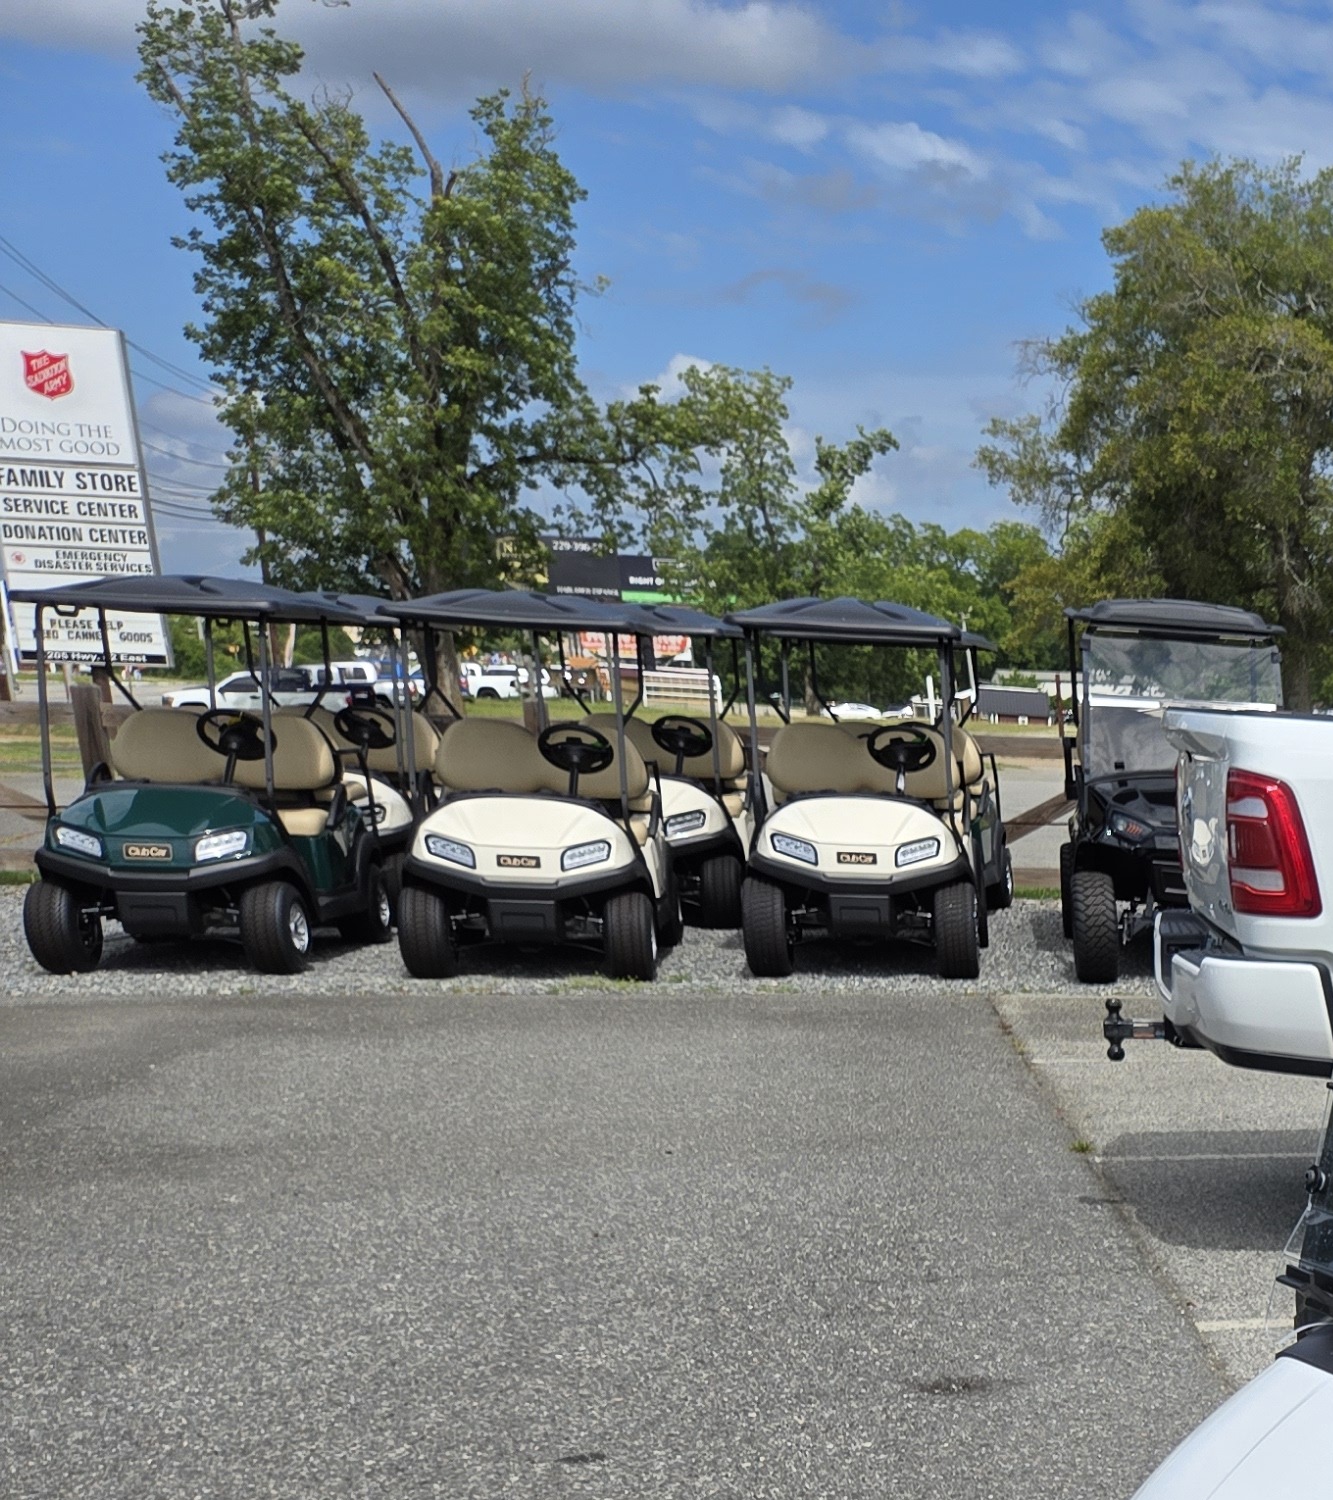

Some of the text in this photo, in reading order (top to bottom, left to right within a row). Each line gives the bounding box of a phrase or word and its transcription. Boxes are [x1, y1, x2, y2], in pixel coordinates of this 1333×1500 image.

[1, 417, 113, 439] DOING THE
[0, 436, 120, 456] MOST GOOD
[75, 472, 139, 493] STORE
[3, 497, 139, 519] SERVICE CENTER
[2, 524, 148, 545] DONATION CENTER
[55, 550, 128, 562] EMERGENCY
[34, 558, 153, 573] DISASTER SERVICES
[50, 618, 124, 632] PLEASE ELP
[68, 630, 103, 642] CANNE
[119, 631, 153, 643] GOODS
[120, 654, 147, 663] East
